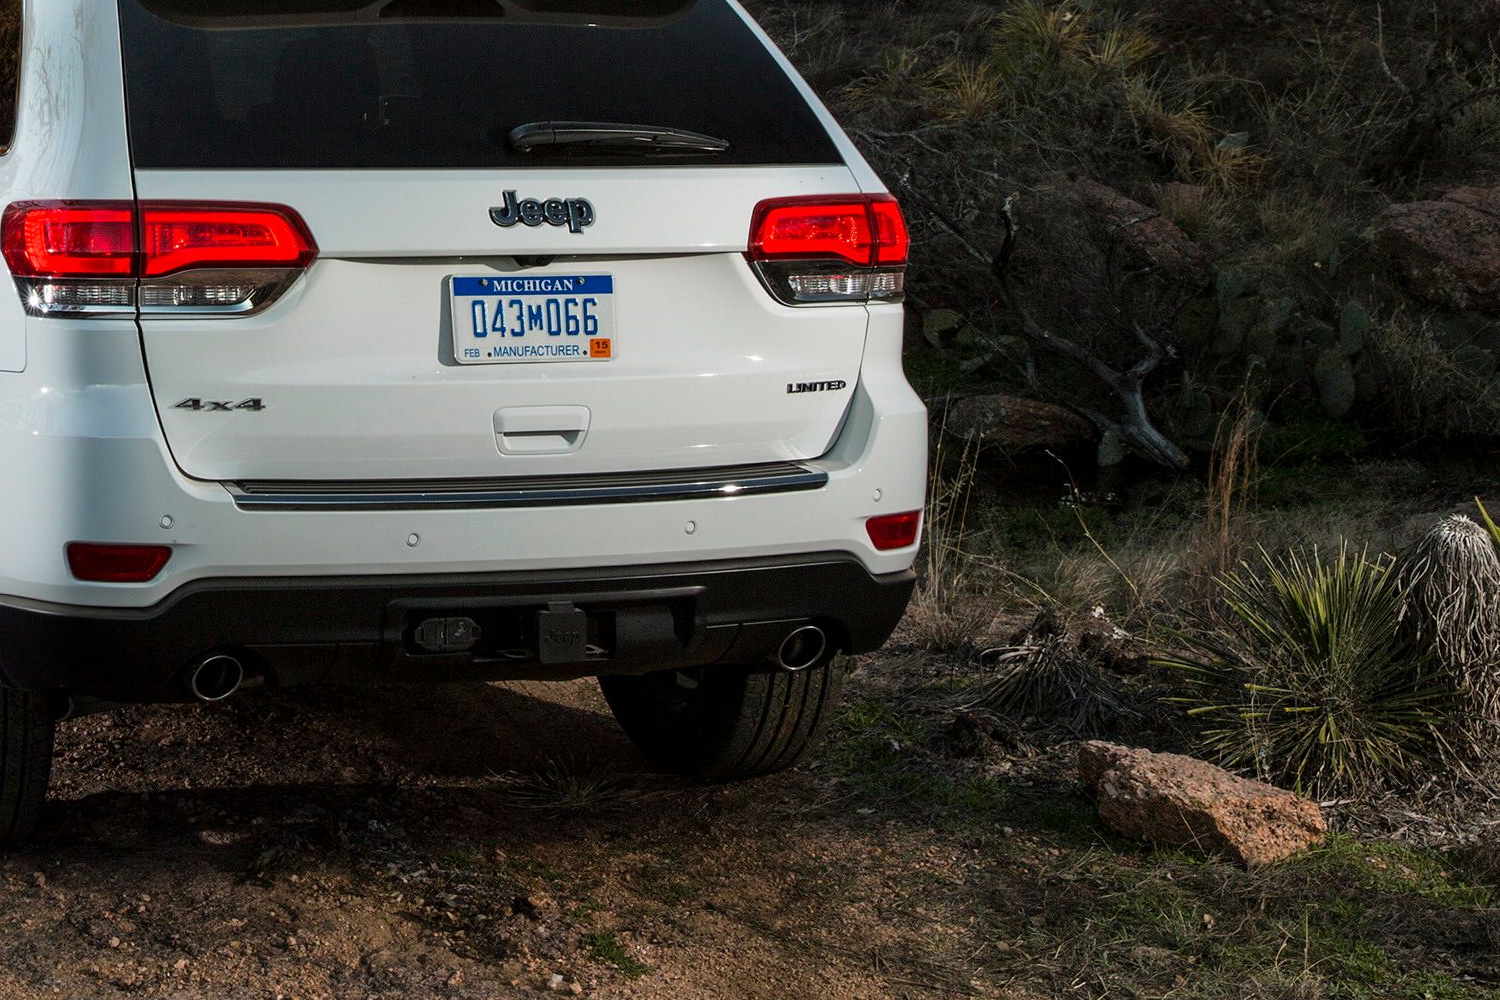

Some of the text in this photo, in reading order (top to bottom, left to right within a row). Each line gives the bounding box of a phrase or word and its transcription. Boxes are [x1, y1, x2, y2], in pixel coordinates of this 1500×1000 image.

[488, 190, 595, 234] Jeep
[493, 279, 573, 292] MICHIGAN
[472, 298, 598, 338] 043M066
[464, 345, 580, 358] FEB MANUFACTURER
[595, 341, 608, 350] 15
[786, 380, 846, 394] LIMITED
[167, 397, 266, 412] 4x4
